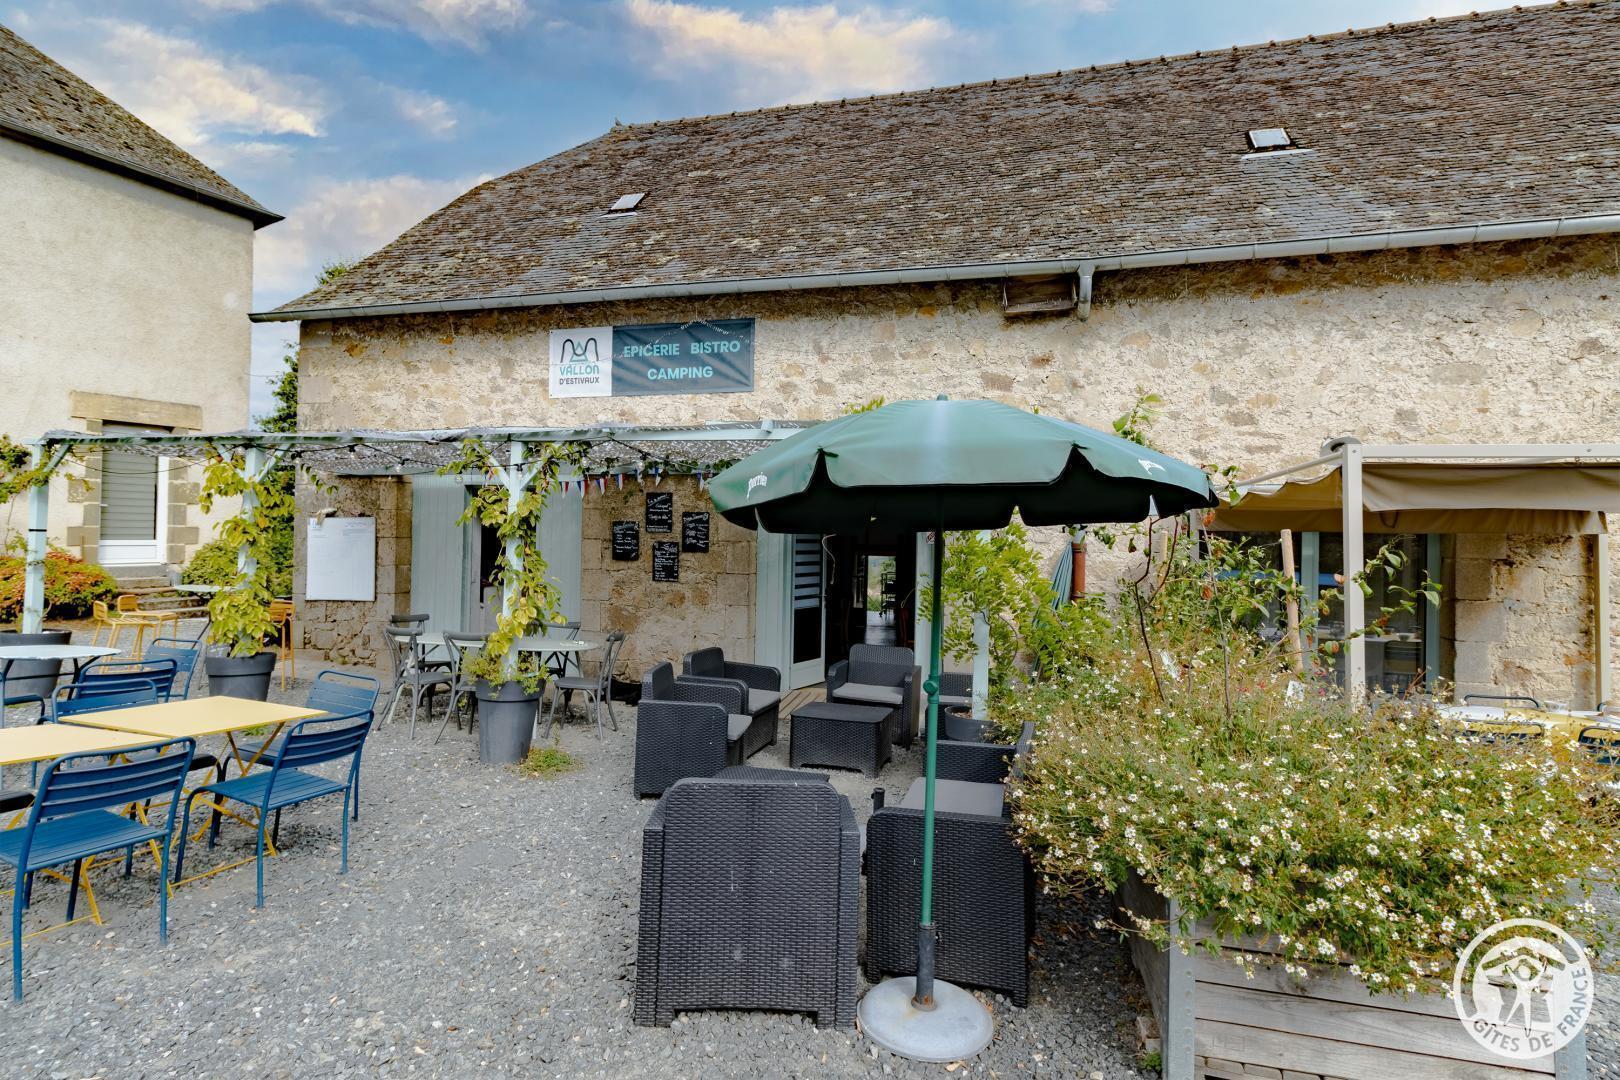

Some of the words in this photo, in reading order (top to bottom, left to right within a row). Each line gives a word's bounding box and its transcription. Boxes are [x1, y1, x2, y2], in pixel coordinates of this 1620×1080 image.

[623, 343, 680, 358] EPICERIE
[690, 340, 741, 355] BISTRO
[559, 364, 600, 376] VALLON
[647, 366, 713, 381] CAMPING
[559, 376, 600, 385] D'ESTIVAUX
